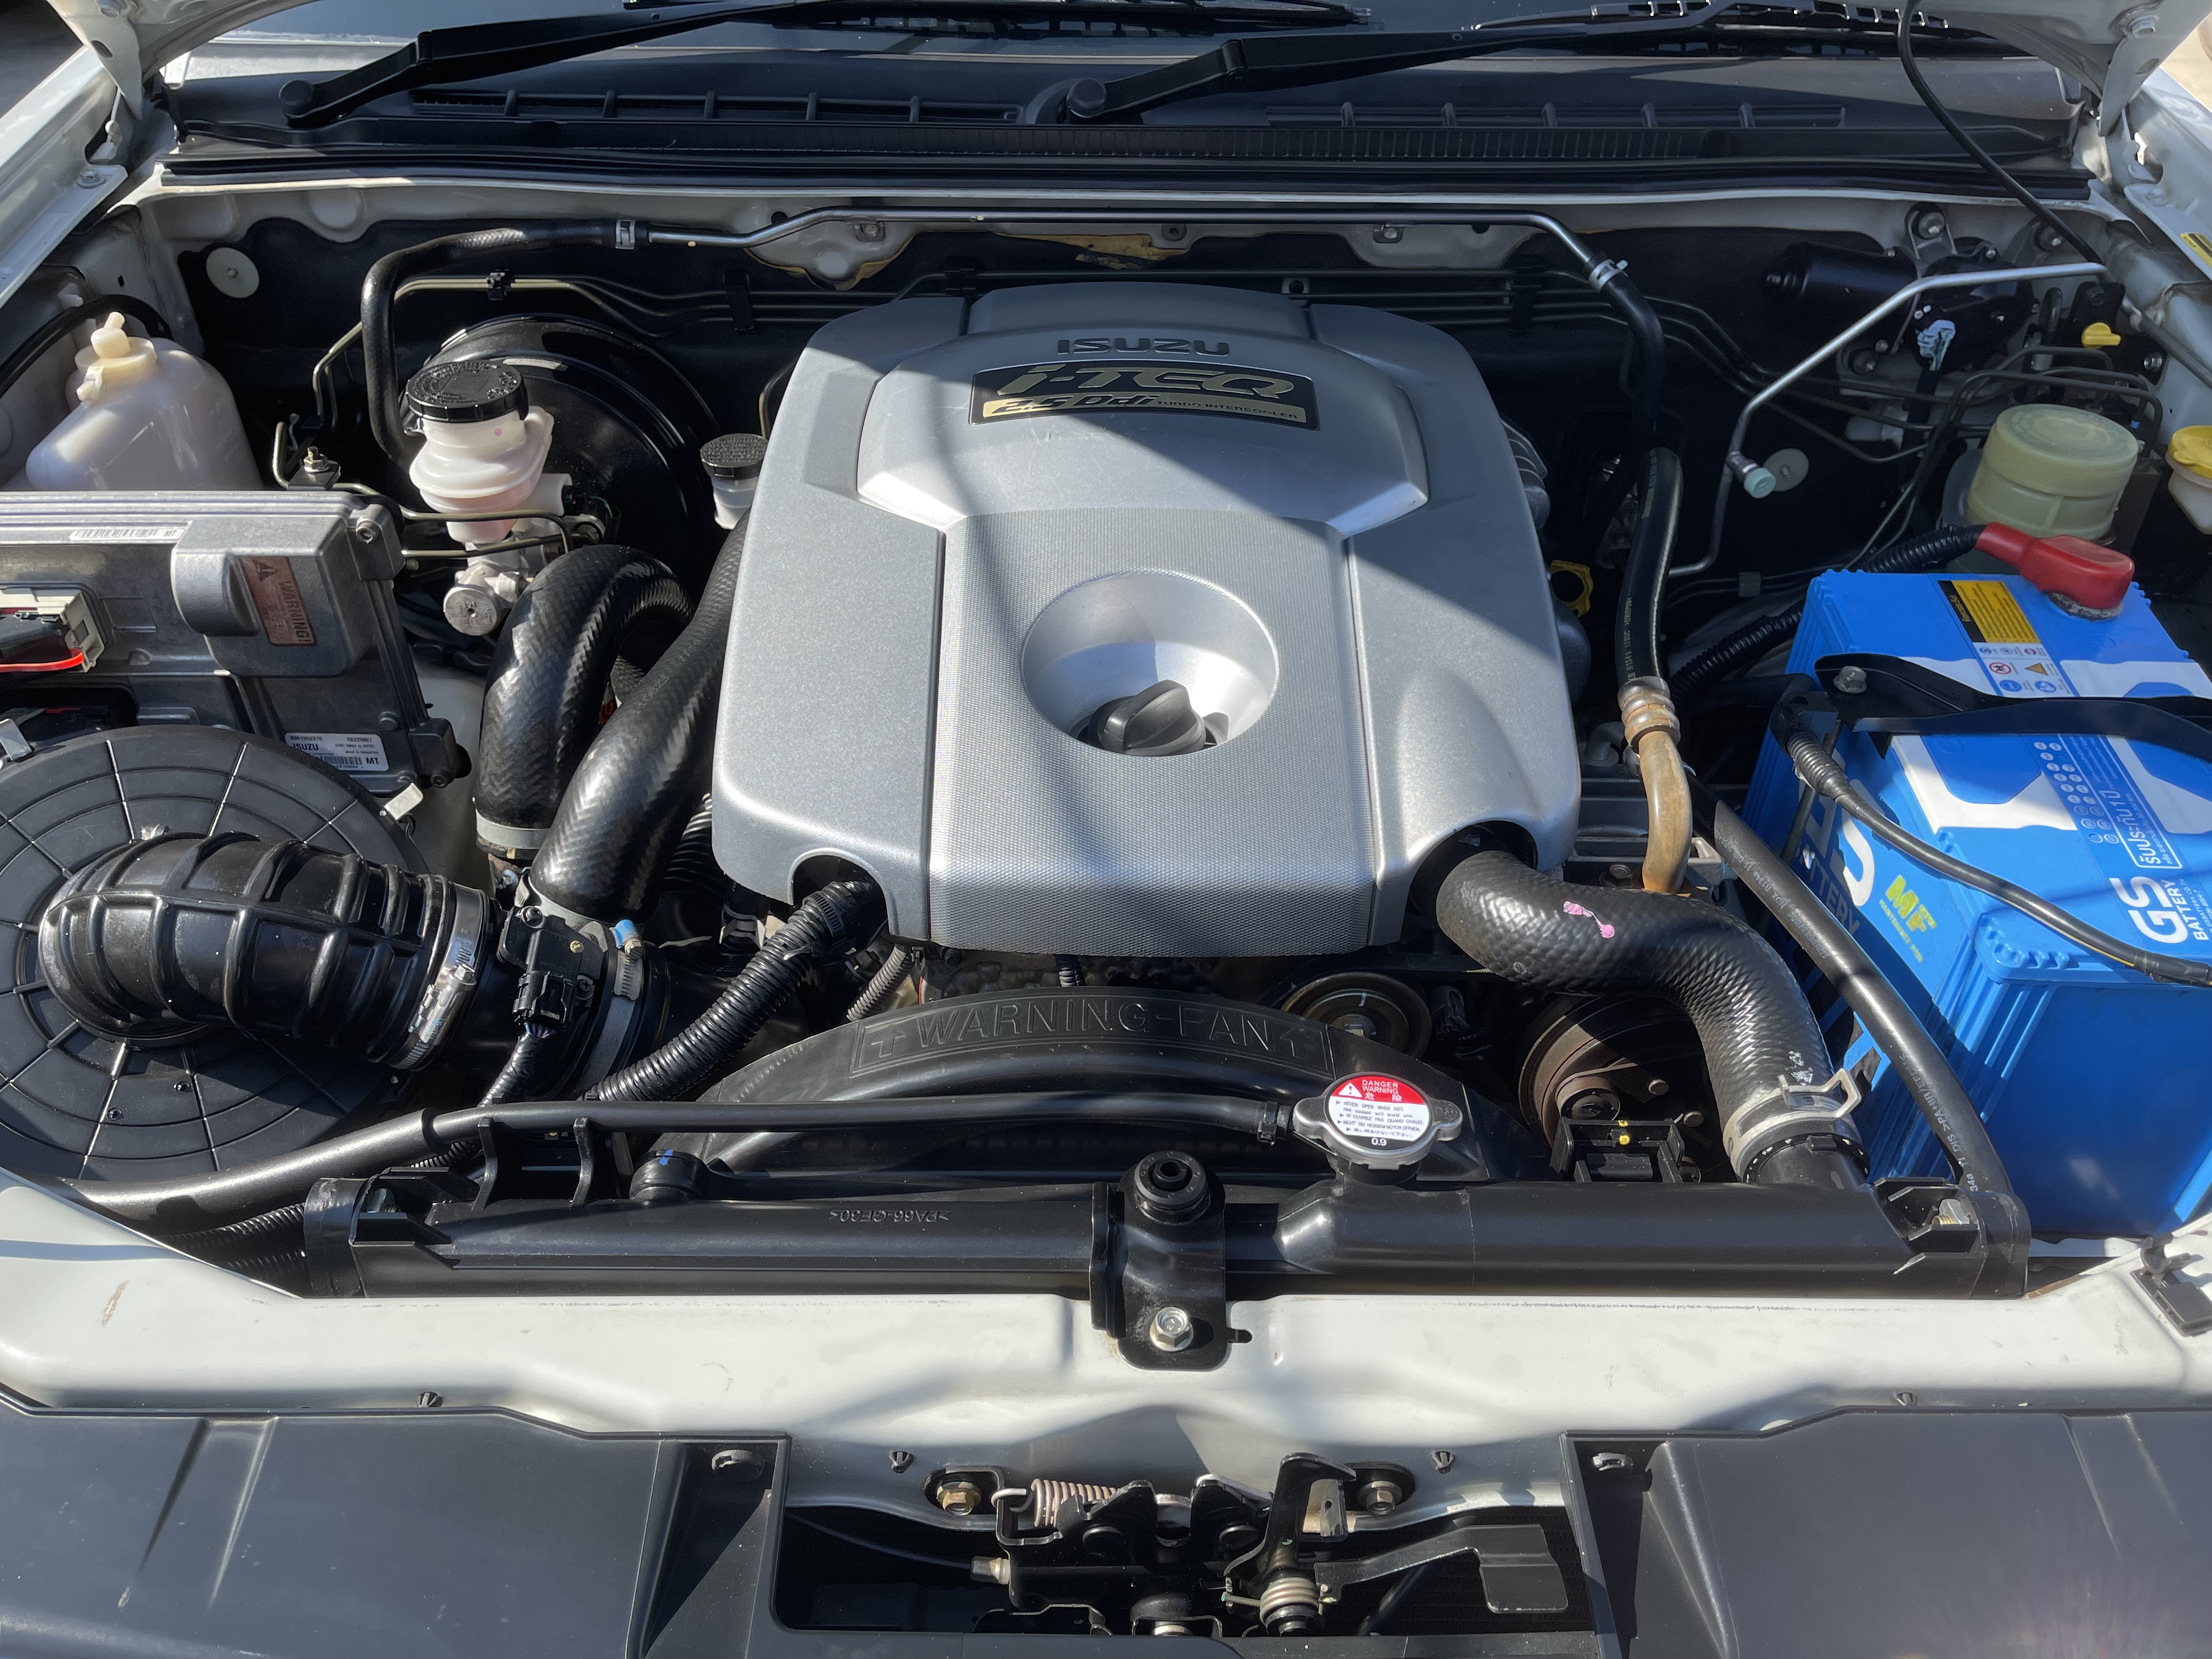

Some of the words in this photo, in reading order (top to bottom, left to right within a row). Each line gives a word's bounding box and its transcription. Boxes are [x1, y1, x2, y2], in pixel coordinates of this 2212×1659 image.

[1058, 337, 1229, 357] ISUZU
[1156, 400, 1201, 408] TURBO
[1205, 403, 1298, 419] INTERCOOLER
[279, 581, 313, 642] WARNING!
[292, 743, 319, 752] ISUZU
[1886, 874, 1937, 933] MF
[2109, 876, 2188, 944] GS
[2160, 879, 2210, 941] BATTERY
[1362, 1079, 1399, 1088] DANGER
[1362, 1085, 1399, 1095] WARNING
[1371, 1137, 1387, 1146] 0.9
[1947, 1133, 1962, 1153] DIS
